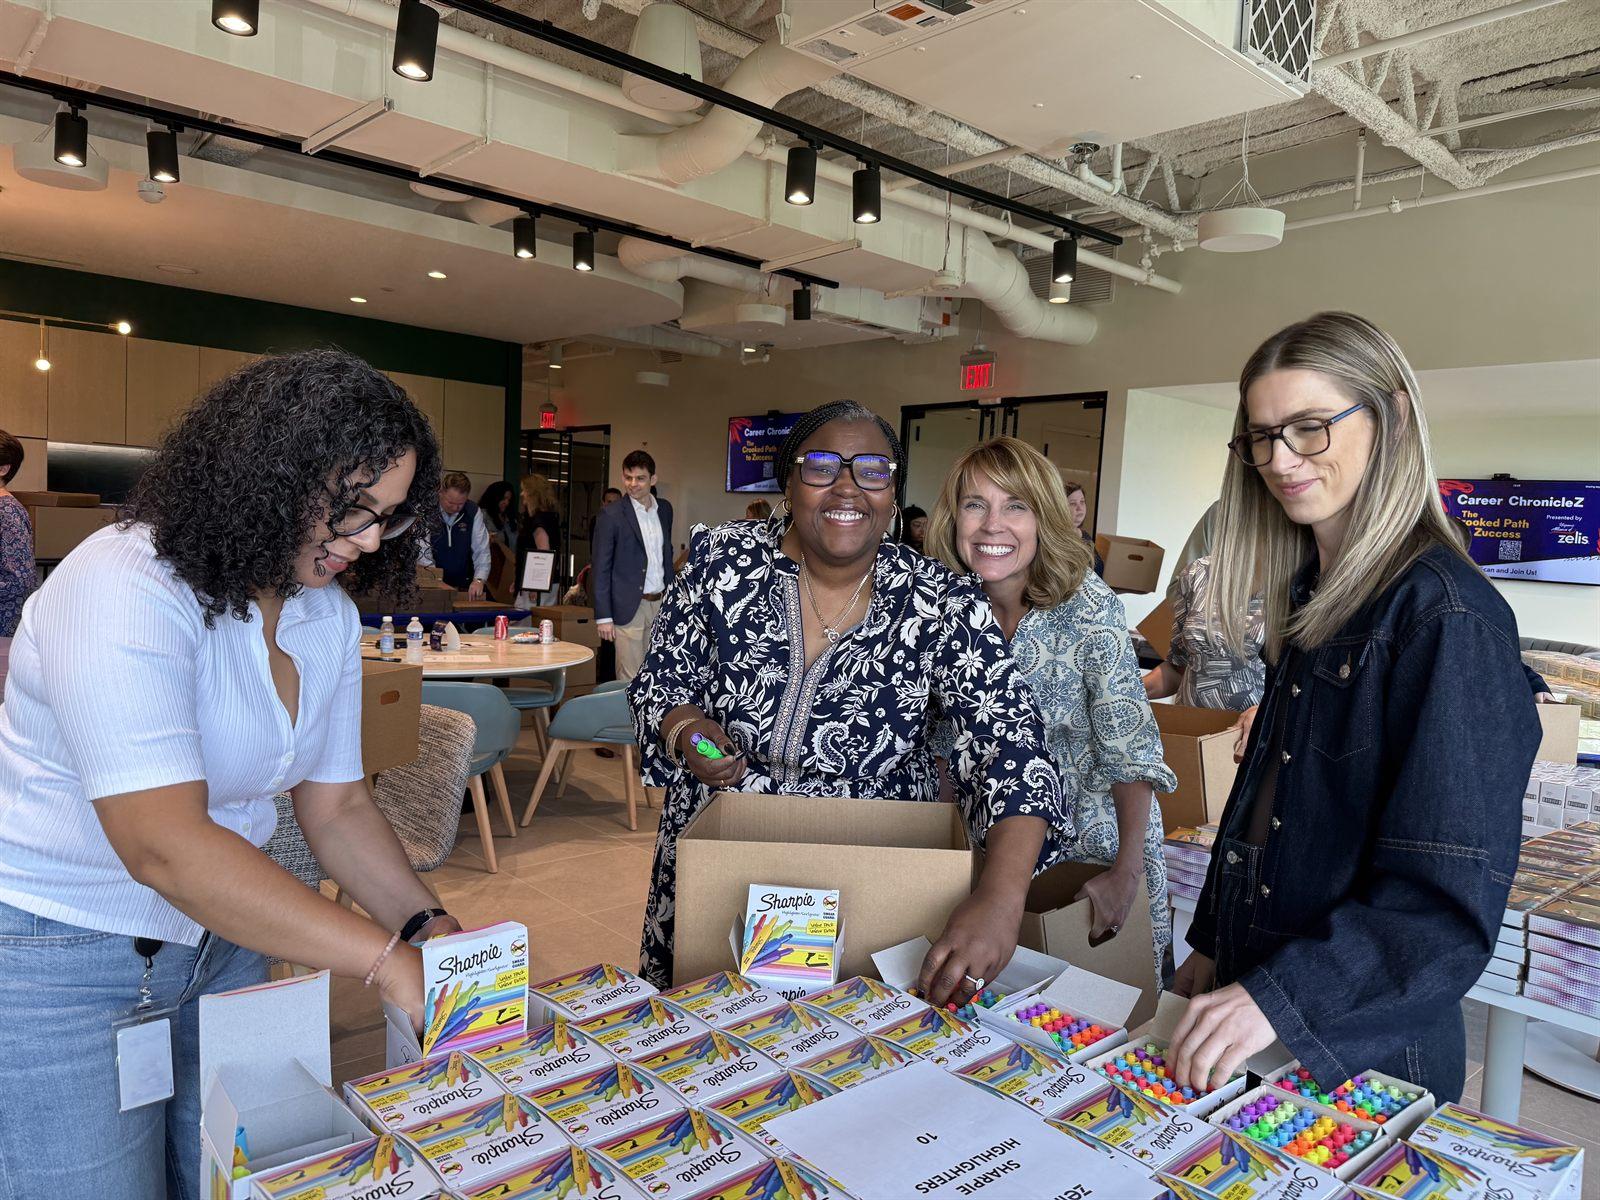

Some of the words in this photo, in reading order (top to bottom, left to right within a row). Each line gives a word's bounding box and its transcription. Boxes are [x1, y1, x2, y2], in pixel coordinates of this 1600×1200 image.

[965, 364, 992, 389] EXIT
[744, 428, 765, 437] Career
[1456, 493, 1504, 506] Career
[1508, 495, 1585, 508] ChronicleZ
[1461, 510, 1478, 518] The
[1473, 527, 1521, 539] Zuccess
[1503, 518, 1530, 529] Path
[1557, 531, 1589, 545] zelis
[756, 893, 816, 912] Sharpie
[435, 943, 502, 984] Sharpie
[591, 980, 641, 1005] Sharpie
[721, 989, 768, 1015] Sharpie
[868, 995, 912, 1021] Sharpie
[636, 1019, 690, 1047] Sharpie
[791, 1024, 840, 1053] Sharpie
[948, 1029, 991, 1058] Sharpie
[529, 1047, 591, 1077] Sharpie
[703, 1054, 758, 1087] Sharpie
[413, 1080, 483, 1114] Sharpie
[1042, 1066, 1086, 1099] Sharpie
[595, 1091, 660, 1126] Sharpie
[471, 1124, 544, 1165] Sharpie
[916, 1132, 938, 1145] 10
[1150, 1114, 1193, 1150] Sharpie
[676, 1142, 742, 1183] Sharpie
[915, 1137, 1022, 1194] HIGHLIGHTERS
[1450, 1141, 1548, 1178] Sharpie
[955, 1159, 1021, 1196] SHARPIE
